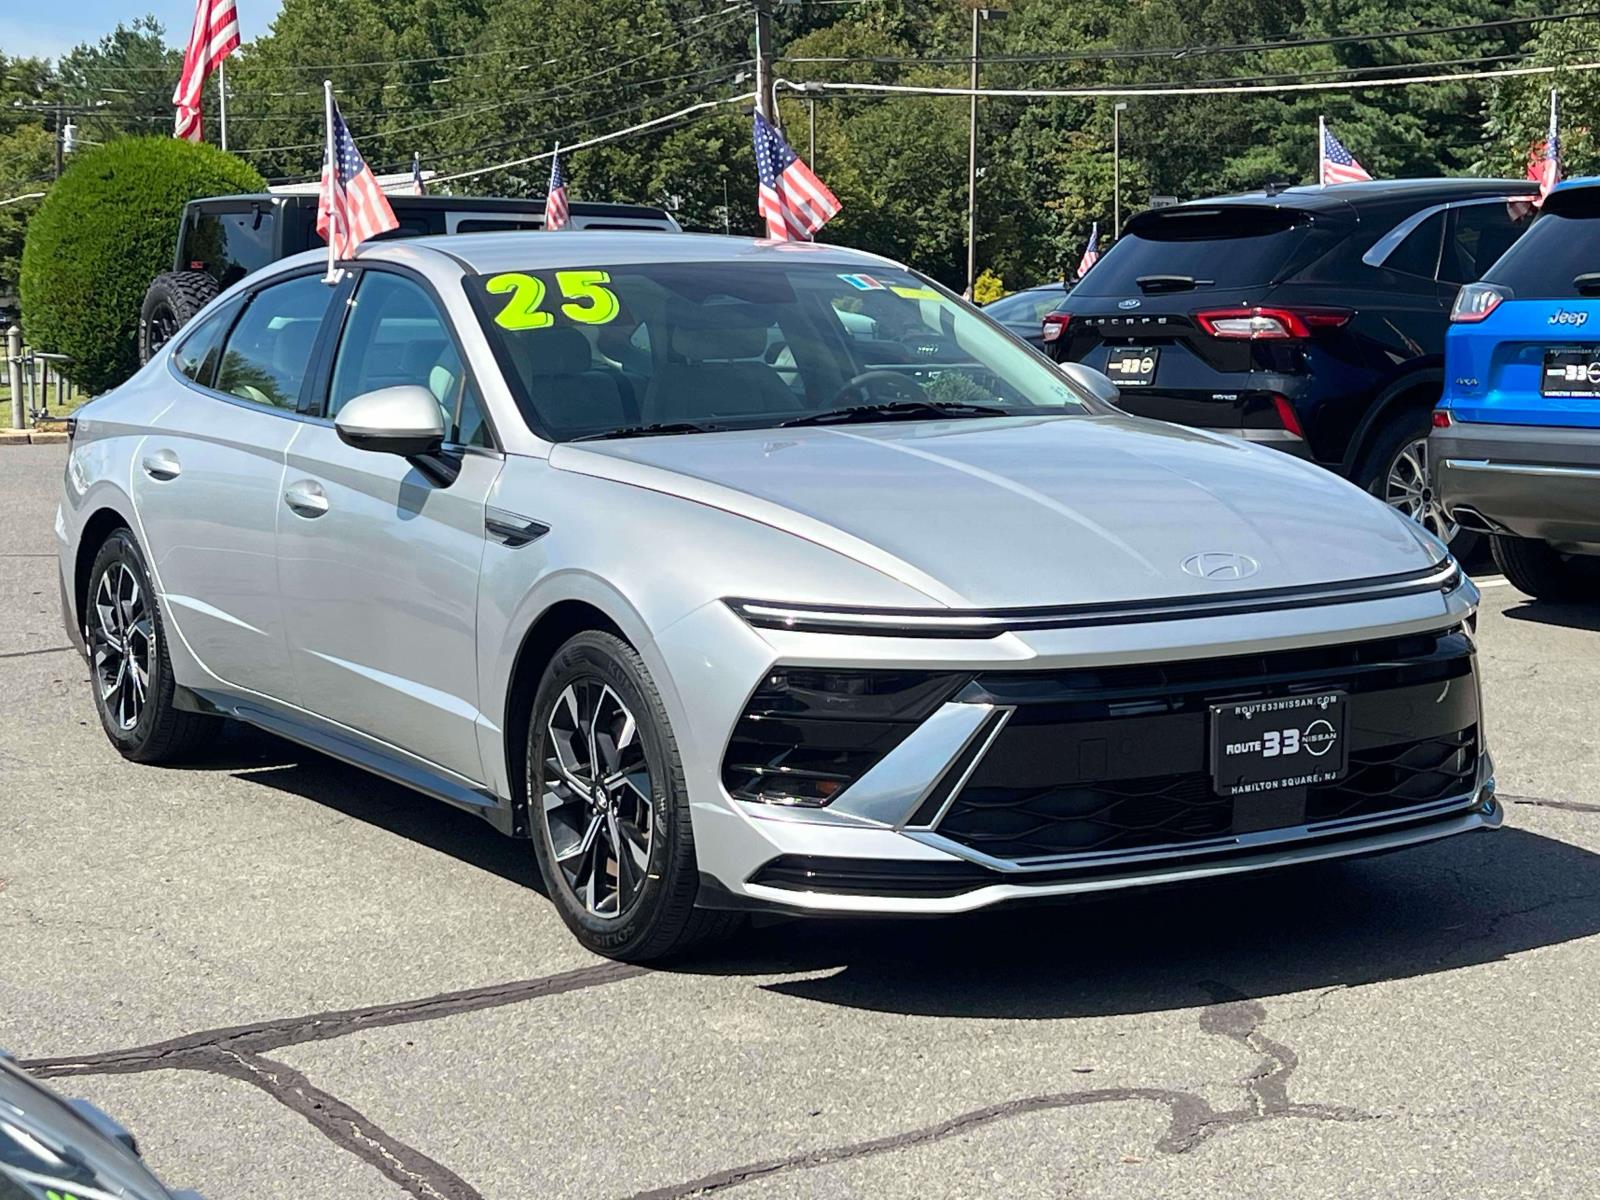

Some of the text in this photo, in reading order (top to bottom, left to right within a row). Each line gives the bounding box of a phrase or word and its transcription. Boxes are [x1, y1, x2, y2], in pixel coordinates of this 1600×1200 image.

[486, 271, 620, 331] 25
[1548, 309, 1587, 326] Jeep
[1235, 695, 1337, 715] ROUTE33NISSAN.COM
[1226, 728, 1337, 758] ROUTE 33 NISSAN
[1231, 772, 1337, 795] HAMILTON SQUARE, NJ
